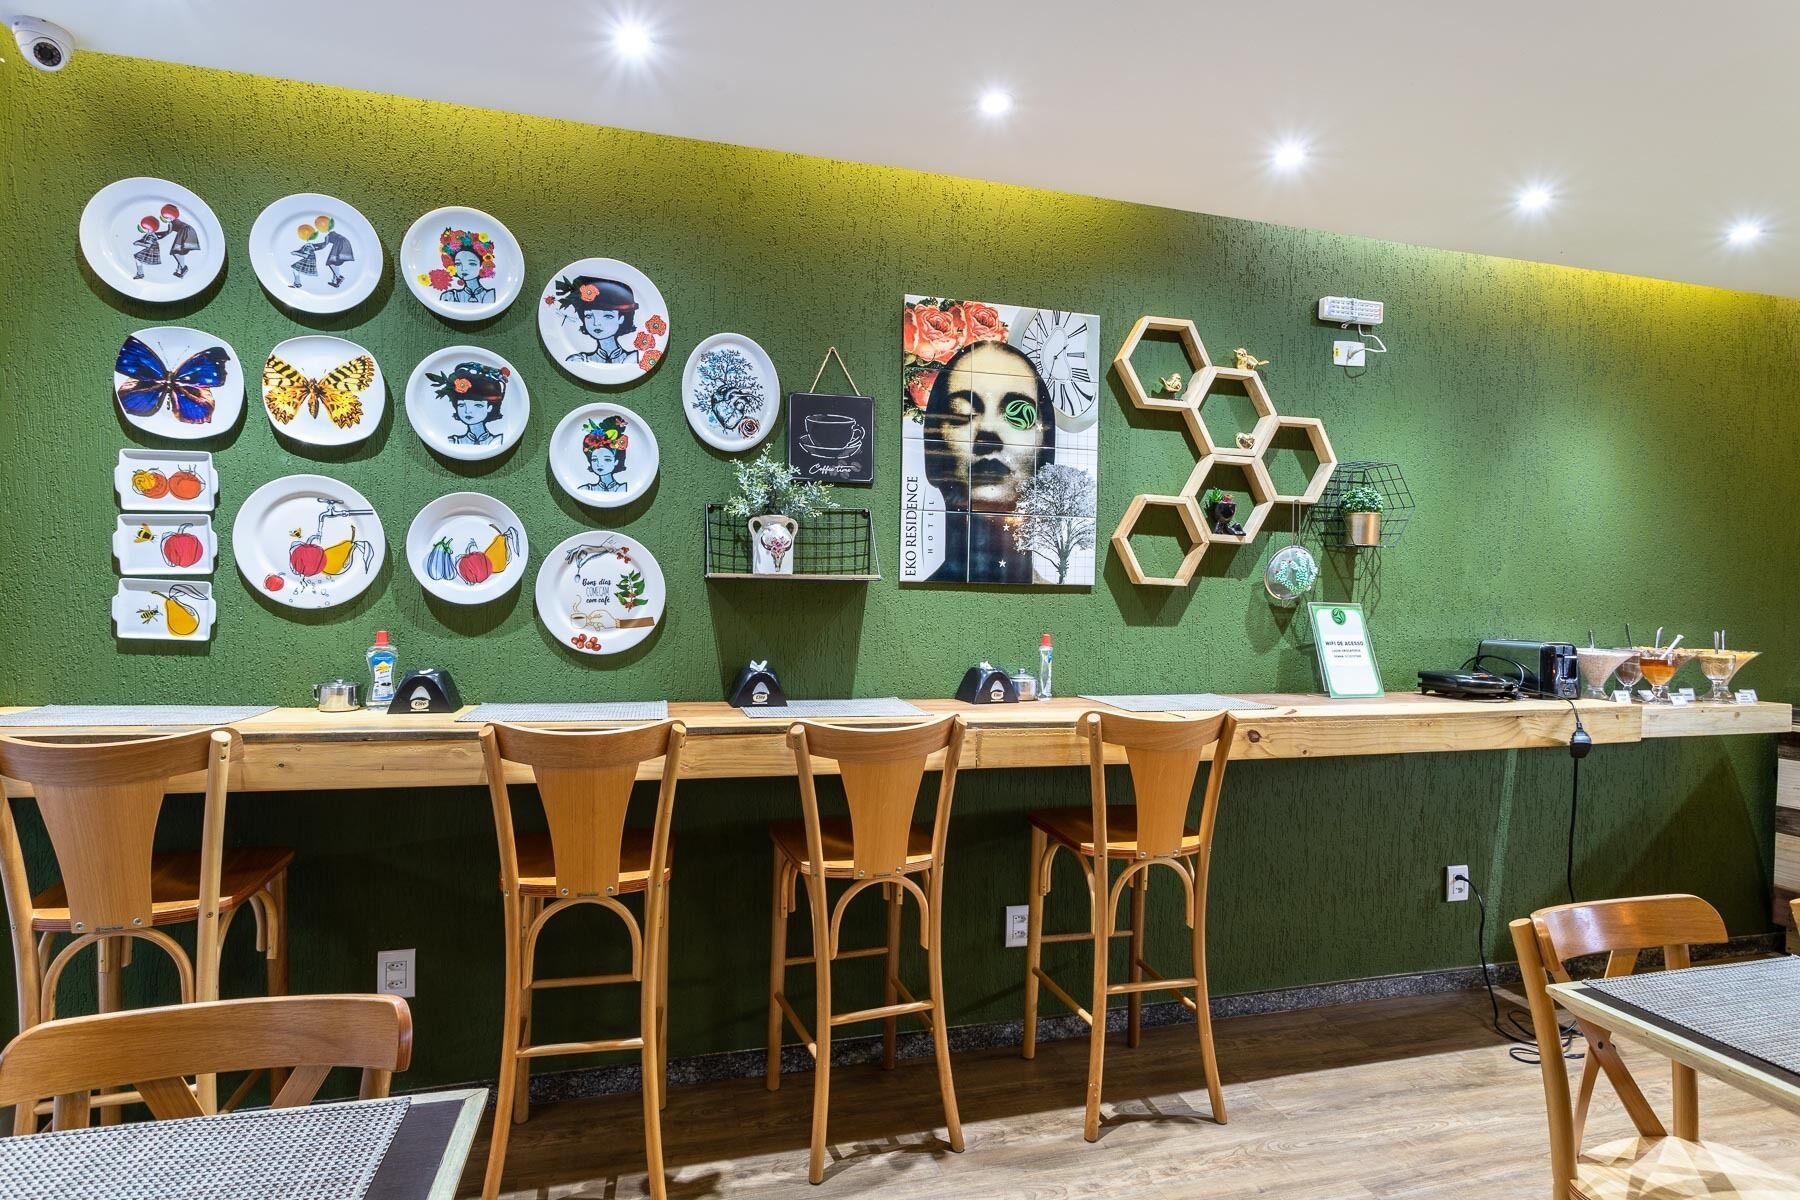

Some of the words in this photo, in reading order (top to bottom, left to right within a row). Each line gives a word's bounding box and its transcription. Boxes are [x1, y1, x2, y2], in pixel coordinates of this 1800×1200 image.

[809, 463, 835, 475] Coffee
[835, 465, 854, 473] time
[906, 476, 919, 547] RESIDENCE
[905, 551, 917, 576] EKO
[598, 578, 611, 586] dias
